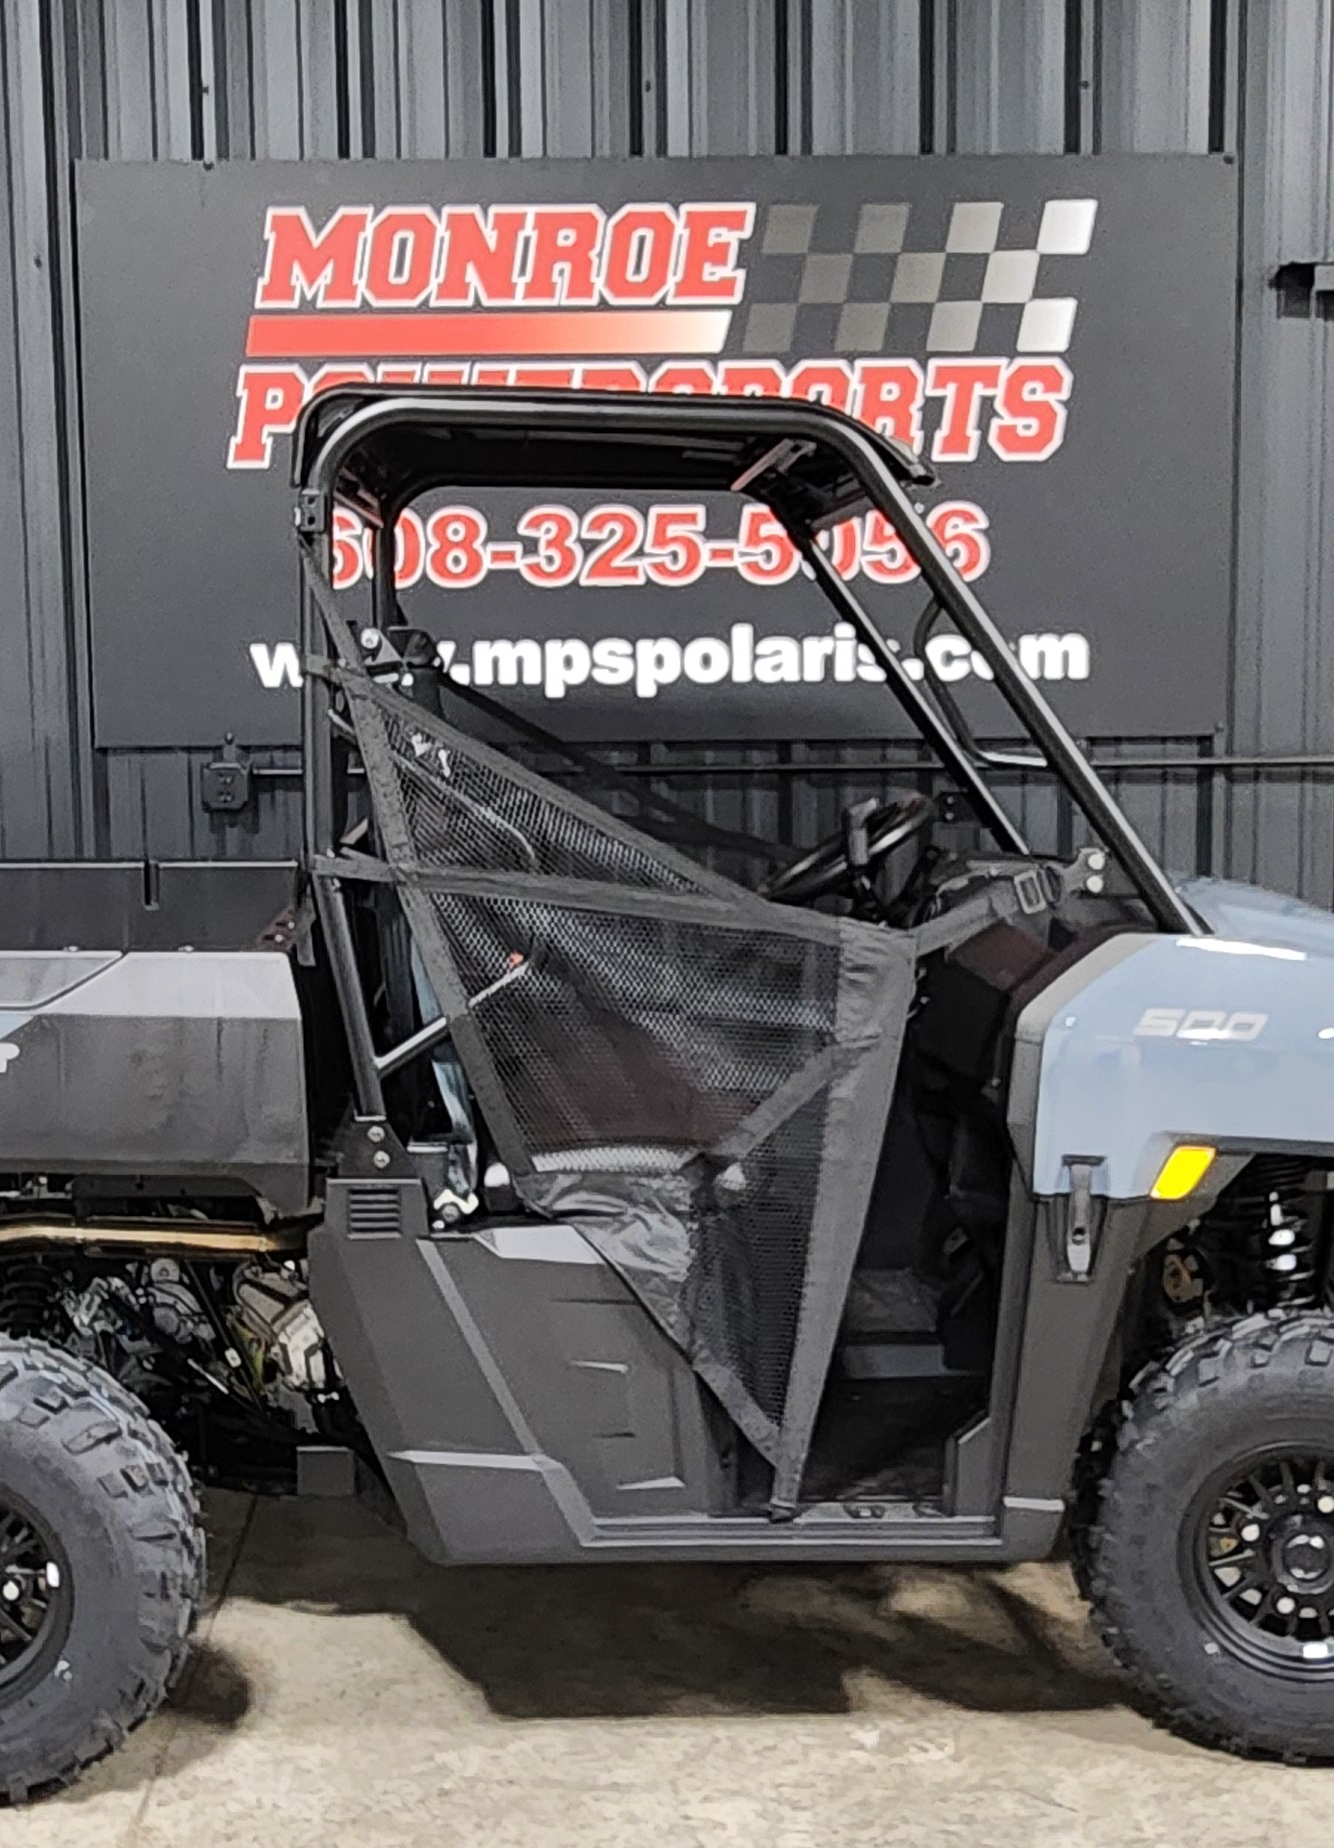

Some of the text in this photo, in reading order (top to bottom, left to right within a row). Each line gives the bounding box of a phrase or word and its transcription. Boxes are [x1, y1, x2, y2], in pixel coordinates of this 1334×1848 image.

[255, 202, 756, 308] MONROE
[249, 622, 1091, 699] w.mpspolaris.cm
[1134, 1007, 1269, 1042] 500
